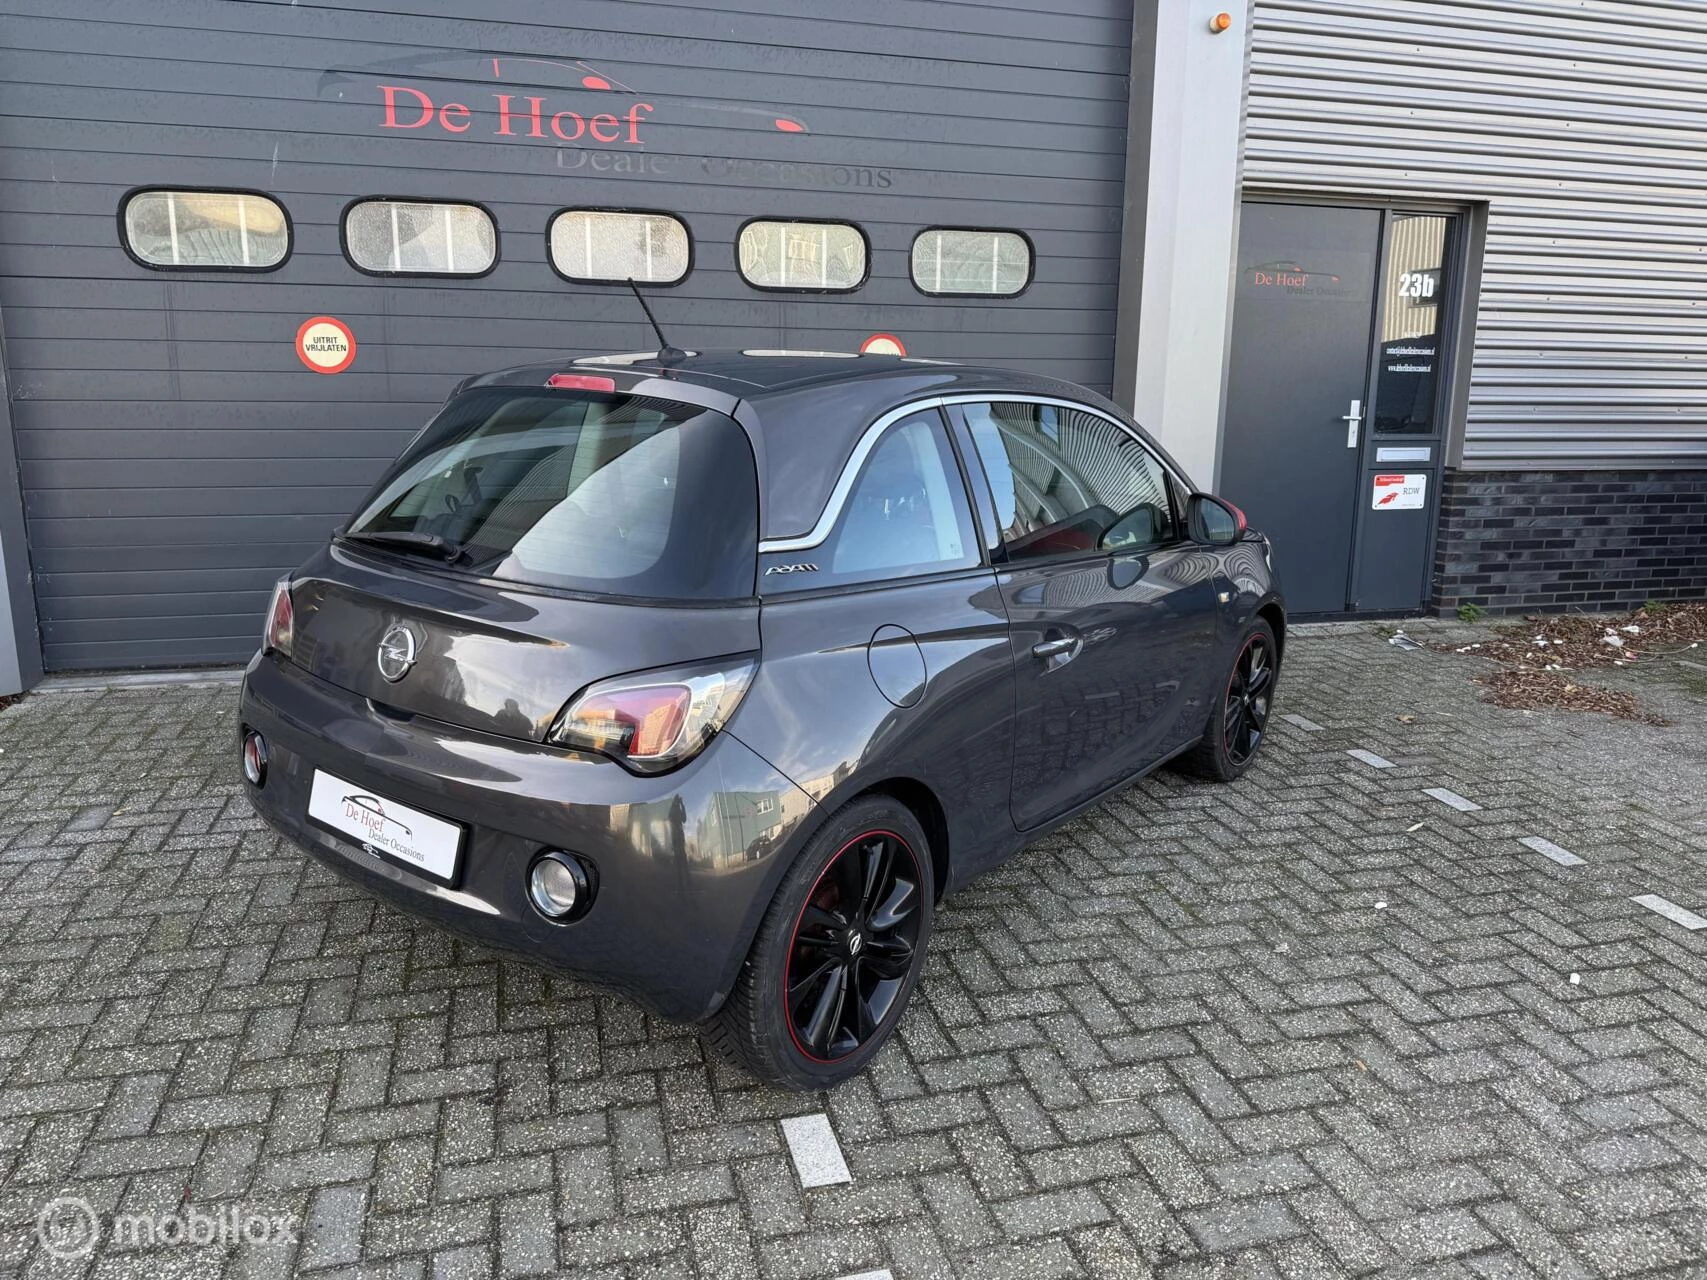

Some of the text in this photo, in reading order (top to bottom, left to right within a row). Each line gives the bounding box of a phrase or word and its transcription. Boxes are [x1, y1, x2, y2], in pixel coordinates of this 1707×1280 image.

[376, 85, 654, 144] De Hoef
[1255, 272, 1309, 287] De Hoef
[1398, 273, 1435, 297] 23b
[305, 344, 347, 352] VRIJLATEN
[313, 336, 338, 344] UITRIT
[1403, 487, 1420, 495] RDW
[345, 802, 386, 832] De Hoef
[368, 828, 425, 862] Dealer Occasions
